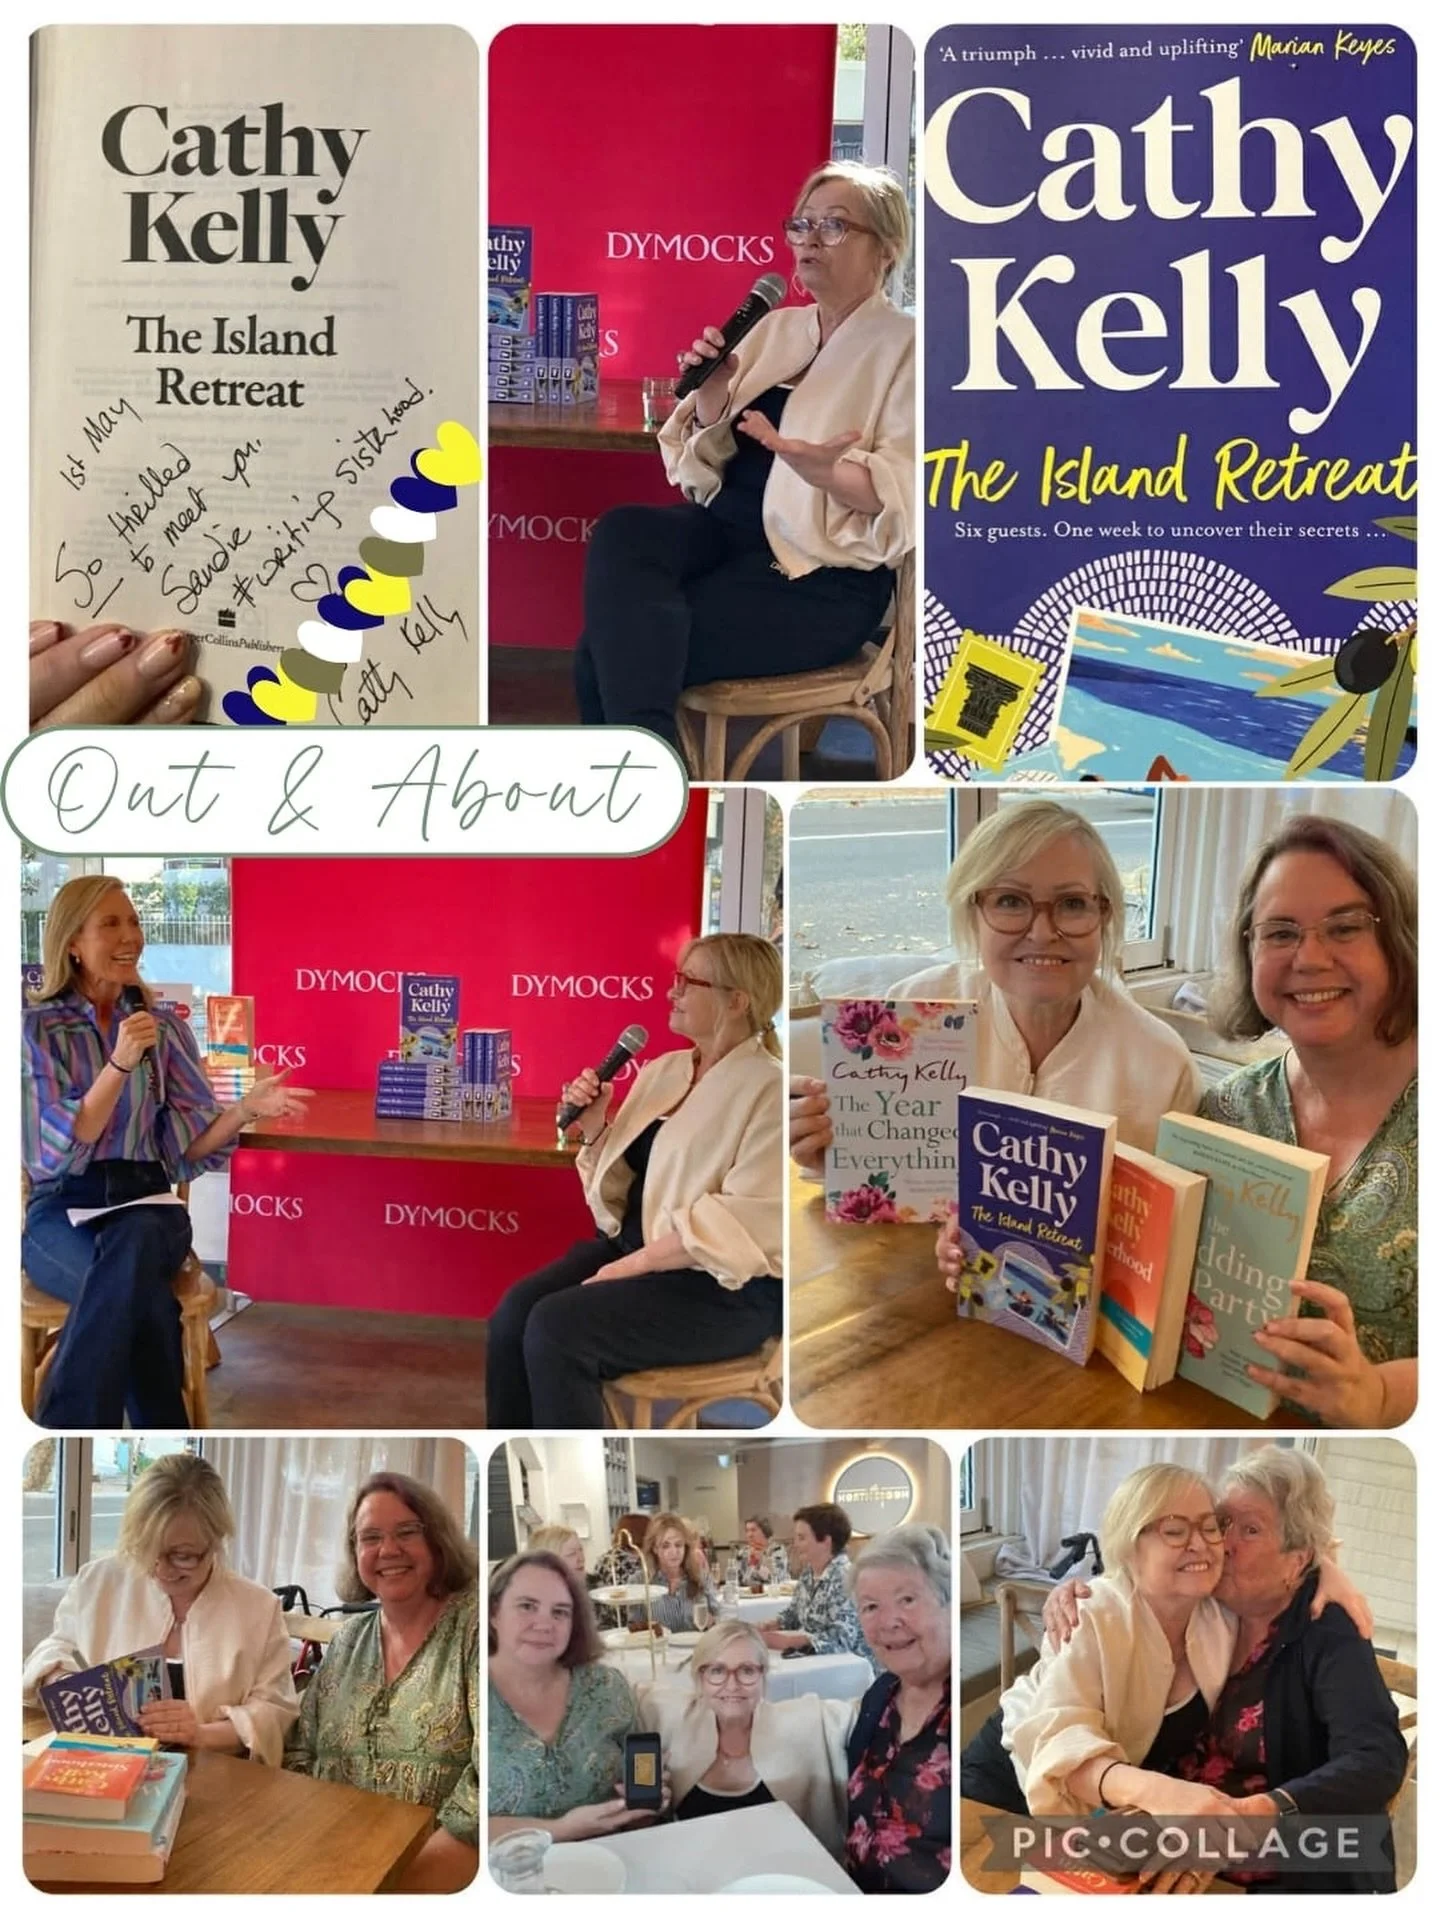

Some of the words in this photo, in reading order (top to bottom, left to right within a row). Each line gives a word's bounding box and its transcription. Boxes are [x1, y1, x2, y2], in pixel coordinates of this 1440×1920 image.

[962, 44, 1037, 66] triumph
[1072, 42, 1113, 59] vivid
[1119, 40, 1153, 58] and
[1250, 31, 1325, 62] Marian
[1334, 29, 1397, 66] Keyes
[101, 102, 370, 205] Cathy
[924, 75, 1414, 264] Cathy
[122, 187, 347, 292] Kelly
[606, 231, 775, 265] DYMOCKS
[126, 314, 202, 356] The
[212, 313, 338, 357] Island
[950, 248, 1382, 434] Kelly
[156, 367, 305, 408] Retreat
[83, 398, 143, 453] May
[924, 439, 1019, 511] The
[1041, 433, 1188, 507] Island
[1214, 437, 1418, 511] Retreat
[55, 541, 103, 609] So
[107, 442, 191, 545] thrilled
[130, 543, 155, 573] to
[163, 487, 208, 547] meet
[488, 513, 599, 542] YMOCK
[955, 521, 982, 538] Six
[987, 523, 1047, 544] guests.
[1054, 521, 1093, 538] One
[1099, 521, 1142, 538] week
[1147, 523, 1165, 538] to
[1170, 523, 1243, 538] uncover
[1249, 520, 1293, 538] their
[1298, 523, 1360, 538] secrets
[160, 523, 252, 615] Sandie
[400, 594, 469, 655] Kelly
[408, 982, 455, 1002] Cathy
[411, 998, 451, 1017] Kelly
[511, 974, 654, 1001] DYMOCKS
[832, 1061, 908, 1093] Cathy
[914, 1061, 967, 1090] Kelly
[836, 1096, 870, 1113] The
[875, 1091, 941, 1117] Year
[835, 1122, 862, 1138] that
[833, 1147, 957, 1178] Everythin
[972, 1121, 1088, 1188] Cathy
[229, 1193, 304, 1221] OCKS
[979, 1163, 1078, 1228] Kelly
[1112, 1183, 1153, 1225] athy
[1240, 1179, 1300, 1243] Kelly
[384, 1202, 520, 1234] DYMOCKS
[971, 1205, 994, 1222] The
[998, 1212, 1033, 1235] Island
[1036, 1222, 1083, 1252] Retreat
[1112, 1211, 1144, 1249] elly
[1198, 1236, 1289, 1310] dding
[57, 1691, 88, 1735] thy
[81, 1686, 114, 1736] elly
